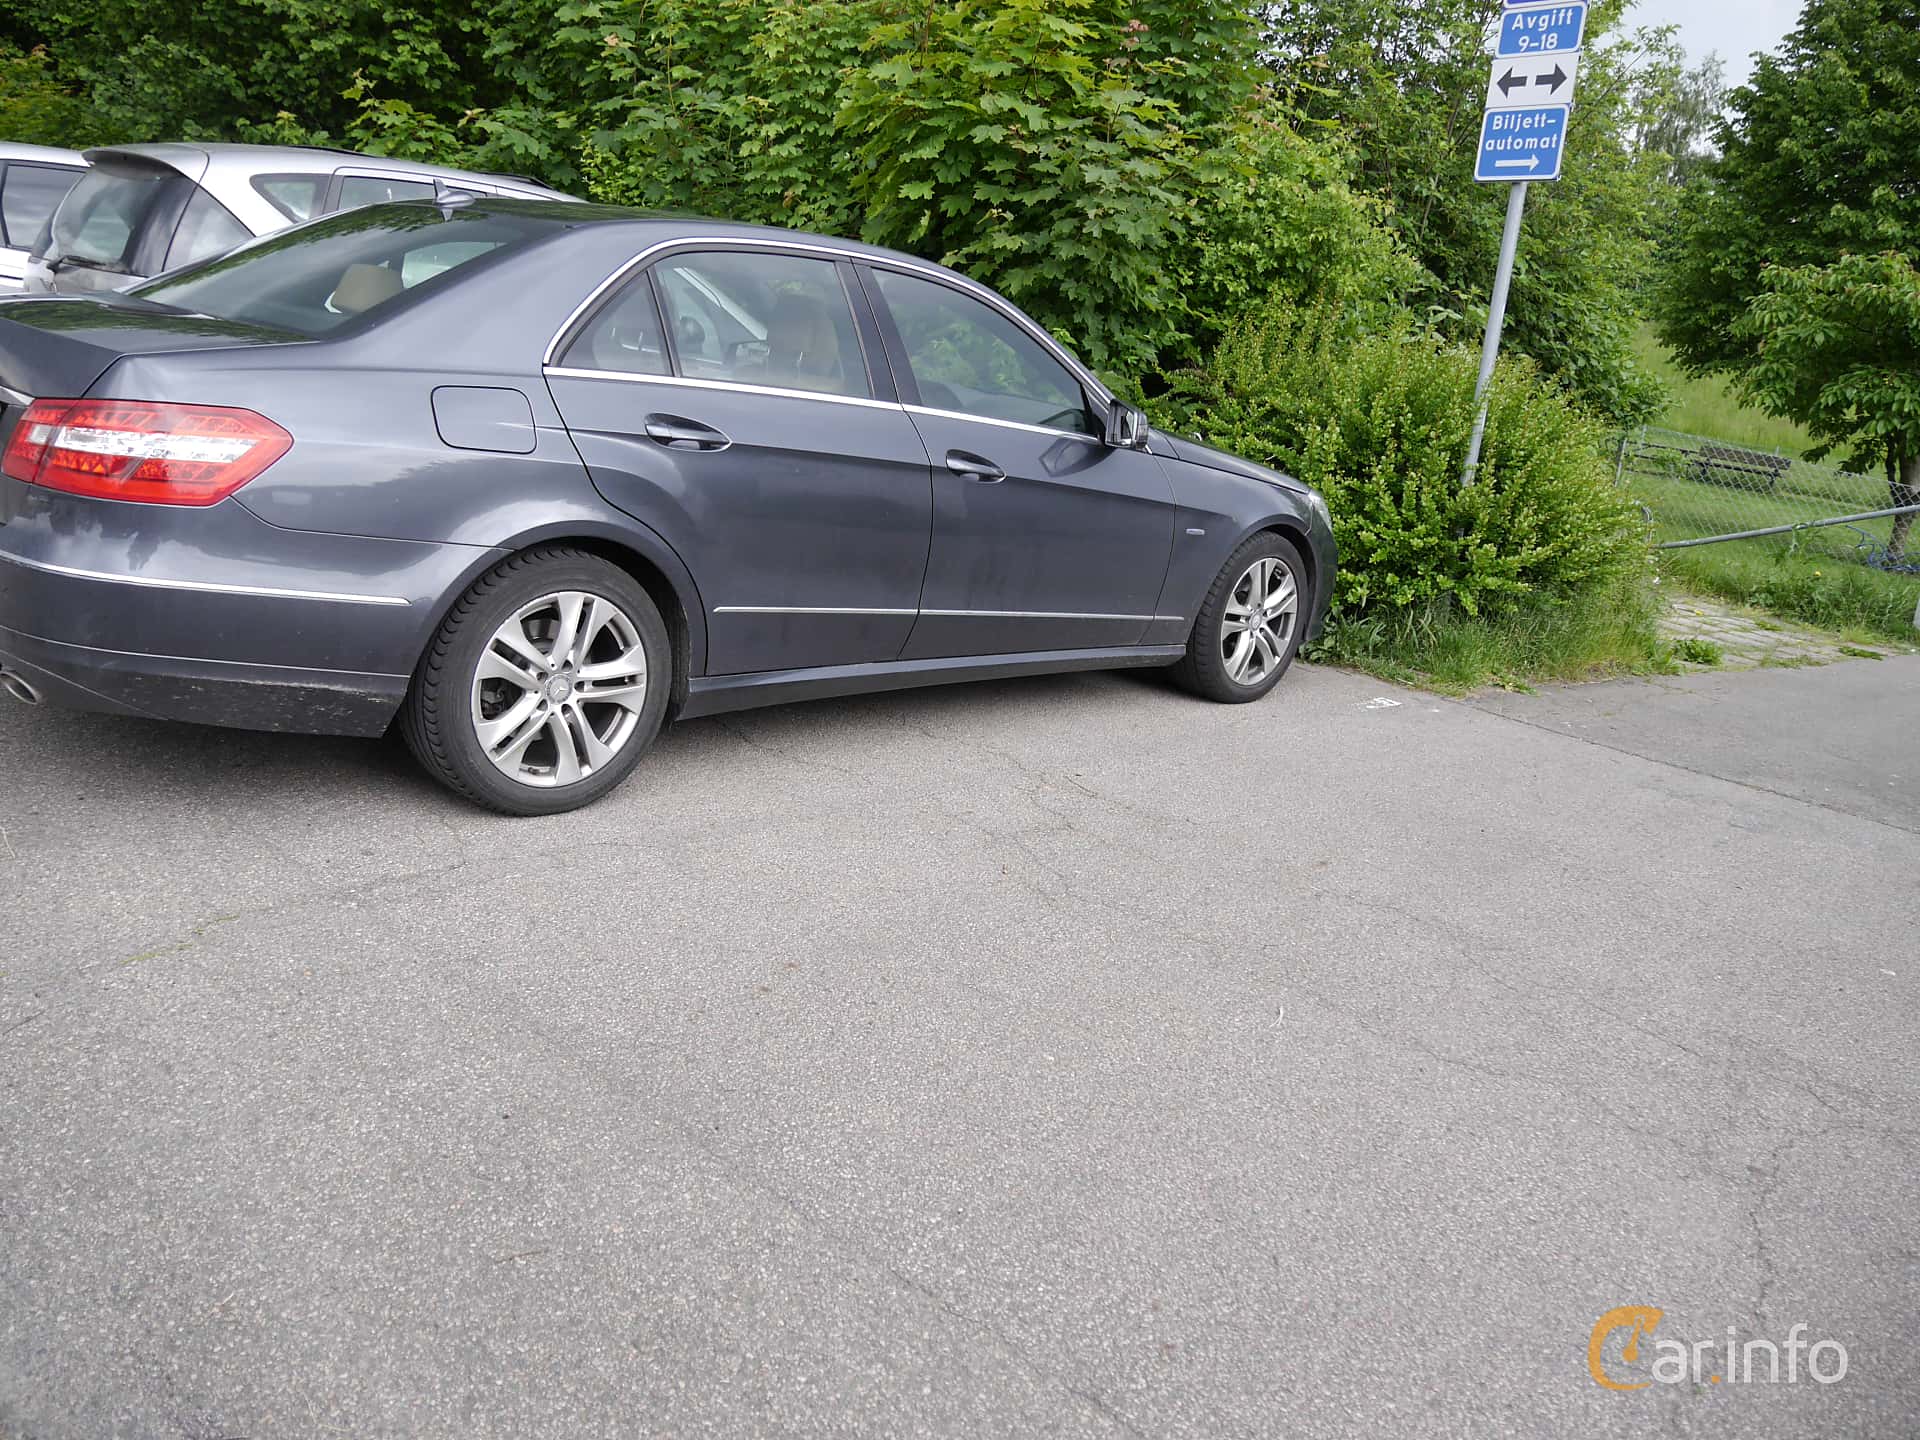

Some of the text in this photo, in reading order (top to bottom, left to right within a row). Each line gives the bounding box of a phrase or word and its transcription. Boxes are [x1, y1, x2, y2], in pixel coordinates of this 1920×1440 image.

[1512, 8, 1574, 31] Avgift
[1518, 33, 1558, 52] 9-18
[1492, 113, 1556, 132] Biljett-
[1485, 134, 1558, 150] automat
